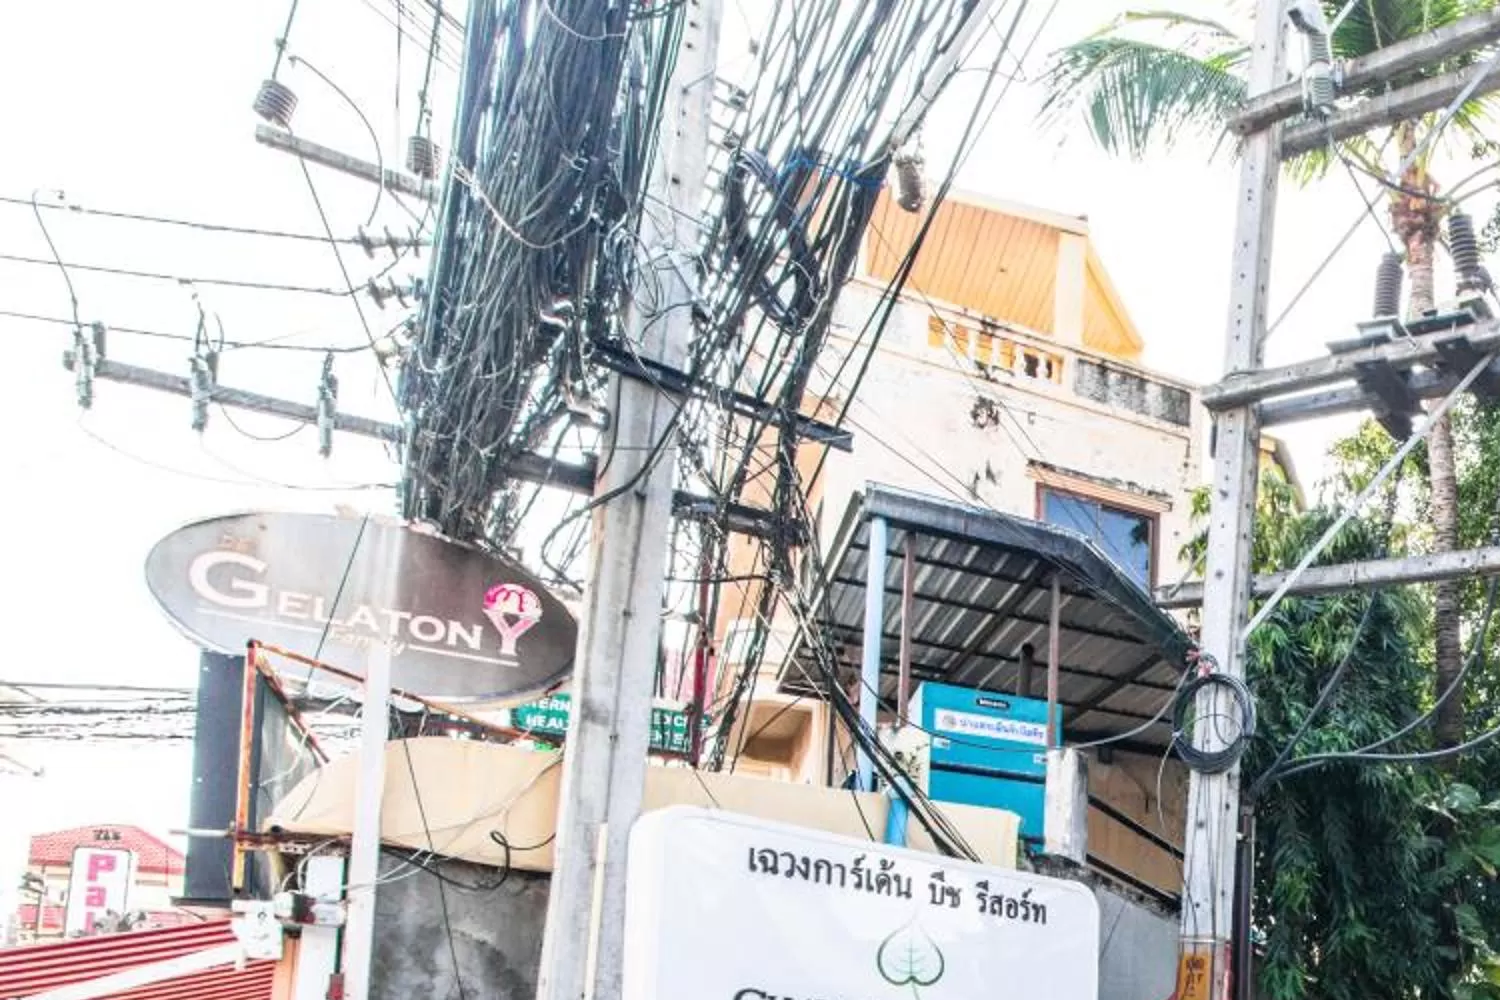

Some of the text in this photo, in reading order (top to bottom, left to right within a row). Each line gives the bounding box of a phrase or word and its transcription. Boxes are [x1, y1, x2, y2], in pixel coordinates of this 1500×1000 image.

[748, 847, 1047, 925] เฉวงการ์เด้น บีช รีสอร์ท
